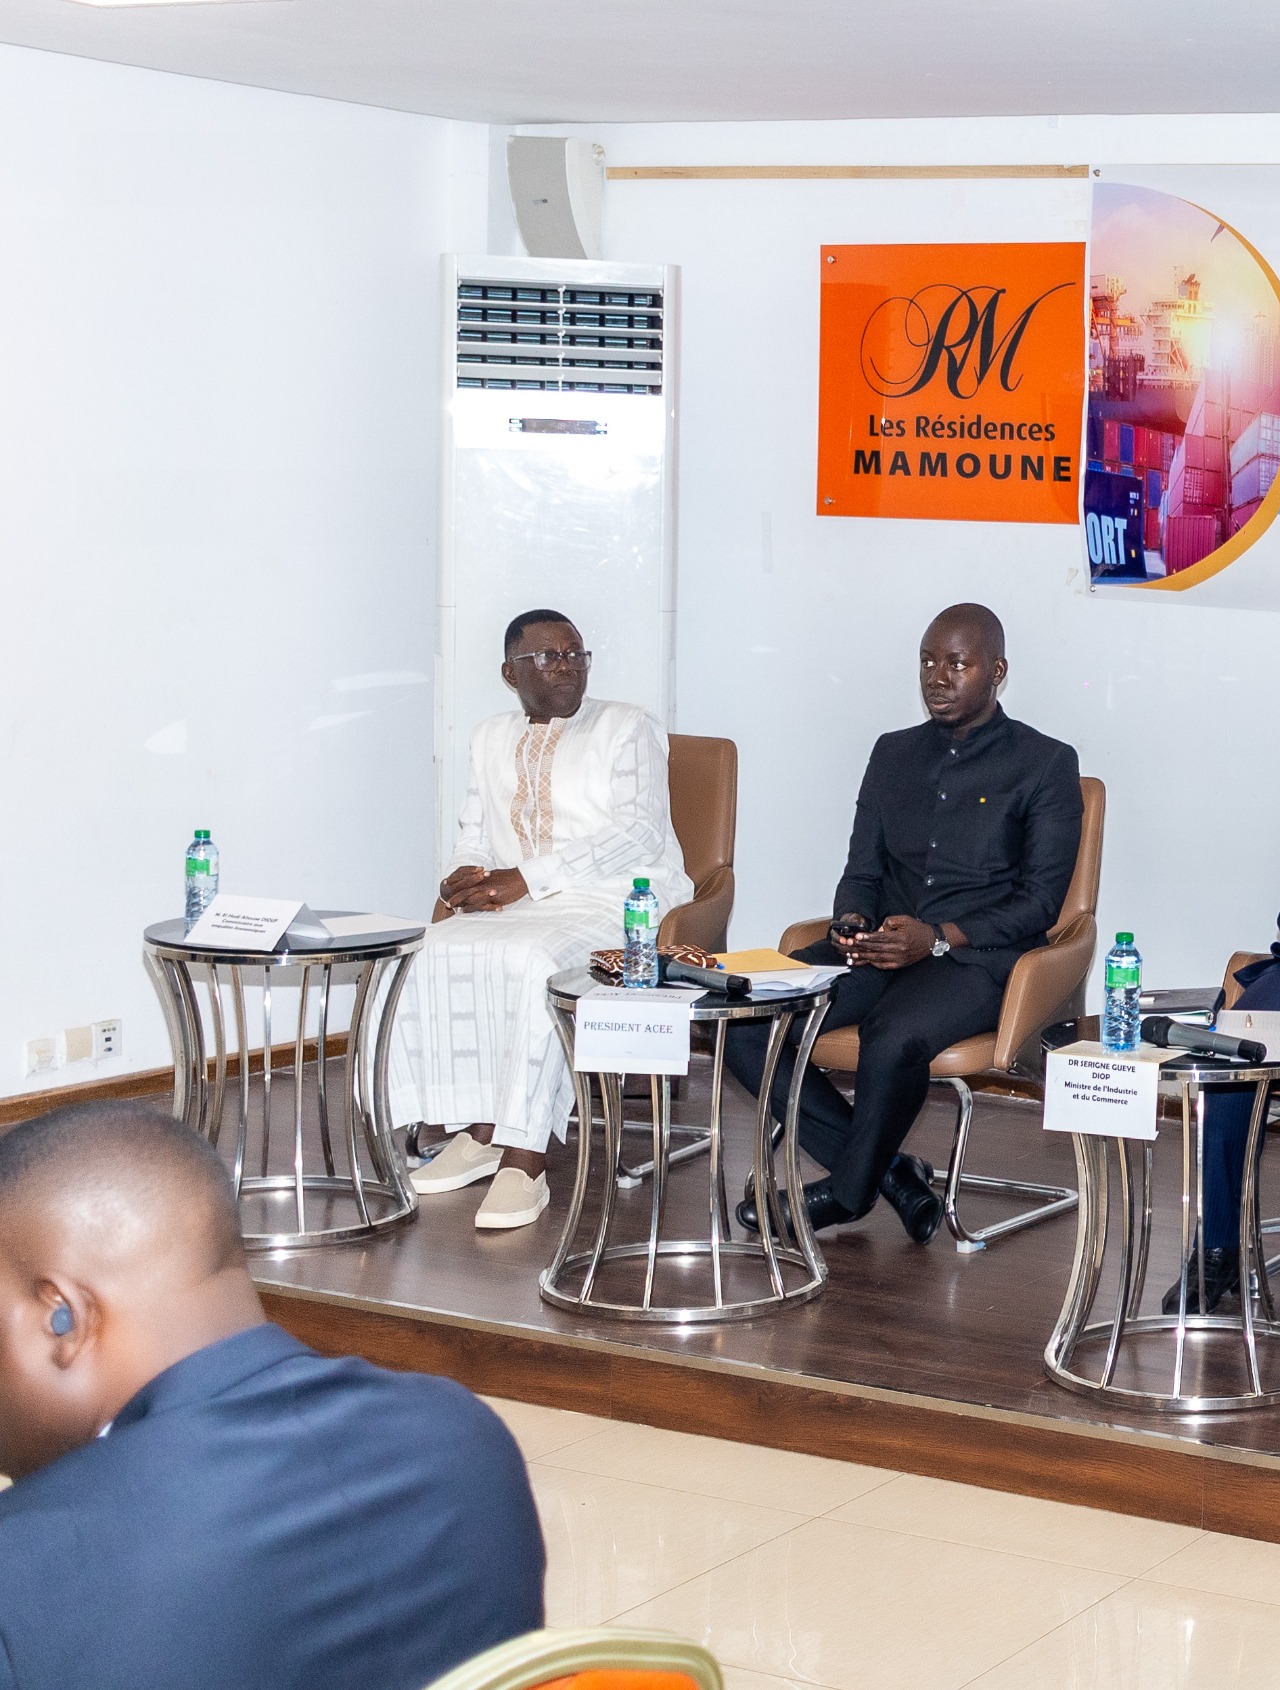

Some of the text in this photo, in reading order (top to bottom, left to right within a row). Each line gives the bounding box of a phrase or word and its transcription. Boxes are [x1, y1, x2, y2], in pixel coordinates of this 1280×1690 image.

[860, 282, 1076, 399] RM
[869, 414, 1056, 441] Les Résidences
[853, 449, 1072, 482] MAMOUNE
[1086, 512, 1128, 565] ORT
[583, 1021, 673, 1034] PRESIDENT ACEE
[1068, 1059, 1136, 1073] DR SERIGNE GUEYE
[1092, 1072, 1111, 1080] DIOP
[1064, 1081, 1091, 1091] Ministre
[1093, 1084, 1101, 1092] de
[1081, 1093, 1090, 1101] du
[1092, 1095, 1128, 1105] Commerce
